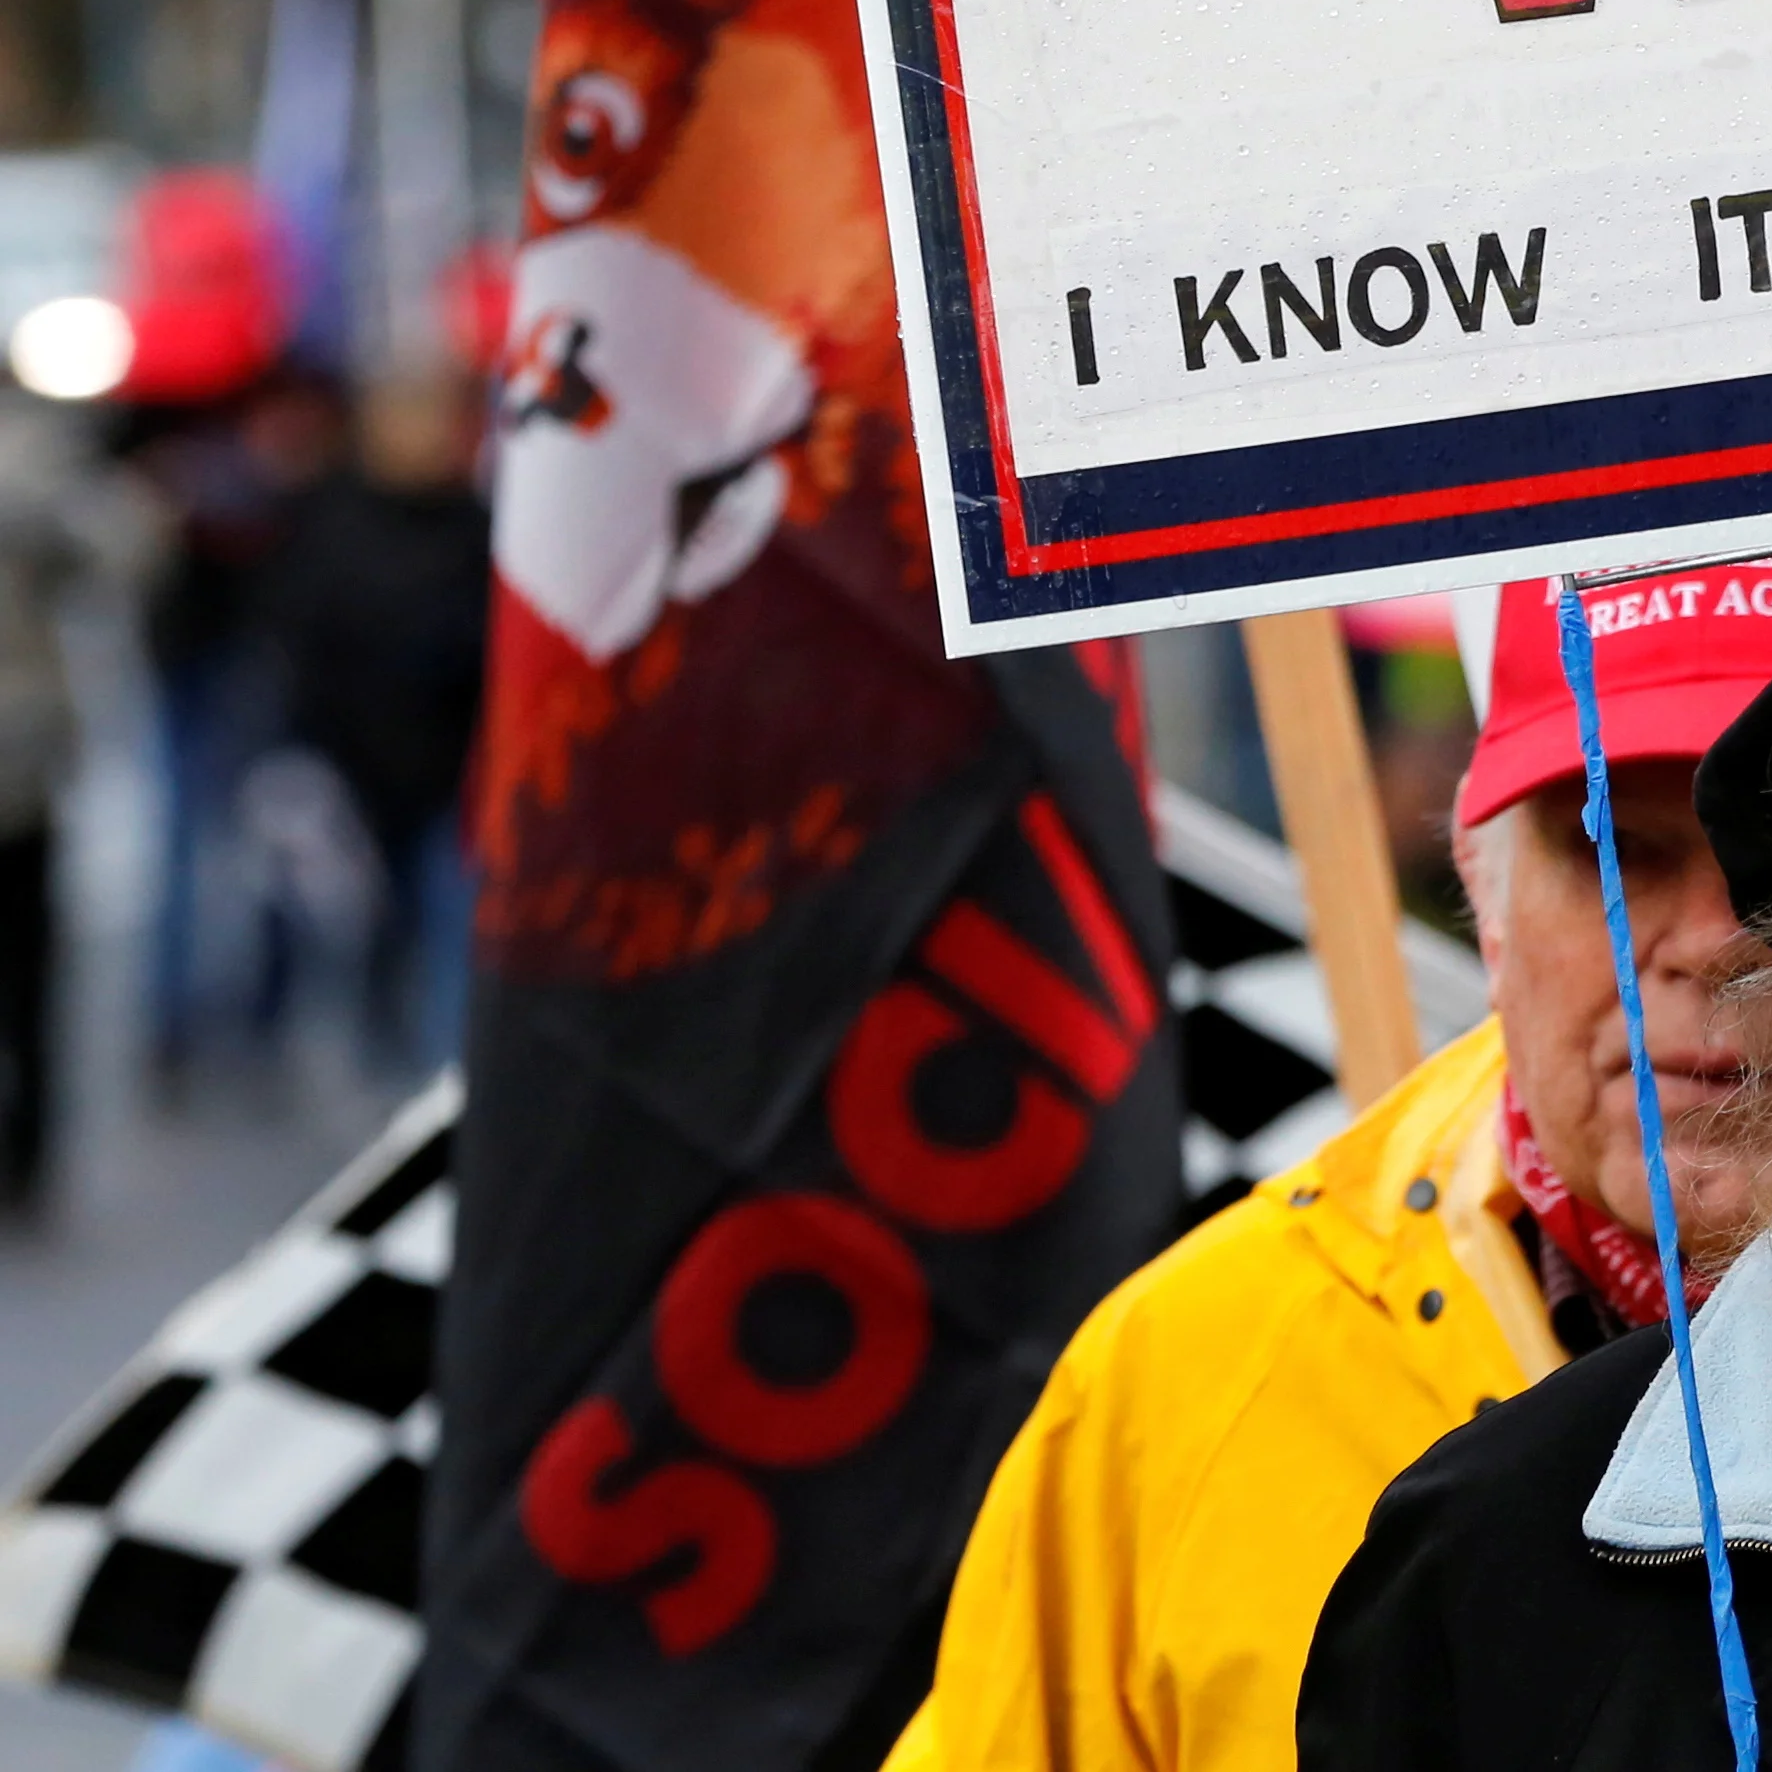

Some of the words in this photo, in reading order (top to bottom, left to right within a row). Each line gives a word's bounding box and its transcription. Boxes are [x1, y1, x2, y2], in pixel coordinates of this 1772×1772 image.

[1066, 287, 1098, 385] I
[1174, 227, 1546, 371] KNOW
[1588, 580, 1706, 638] REAT
